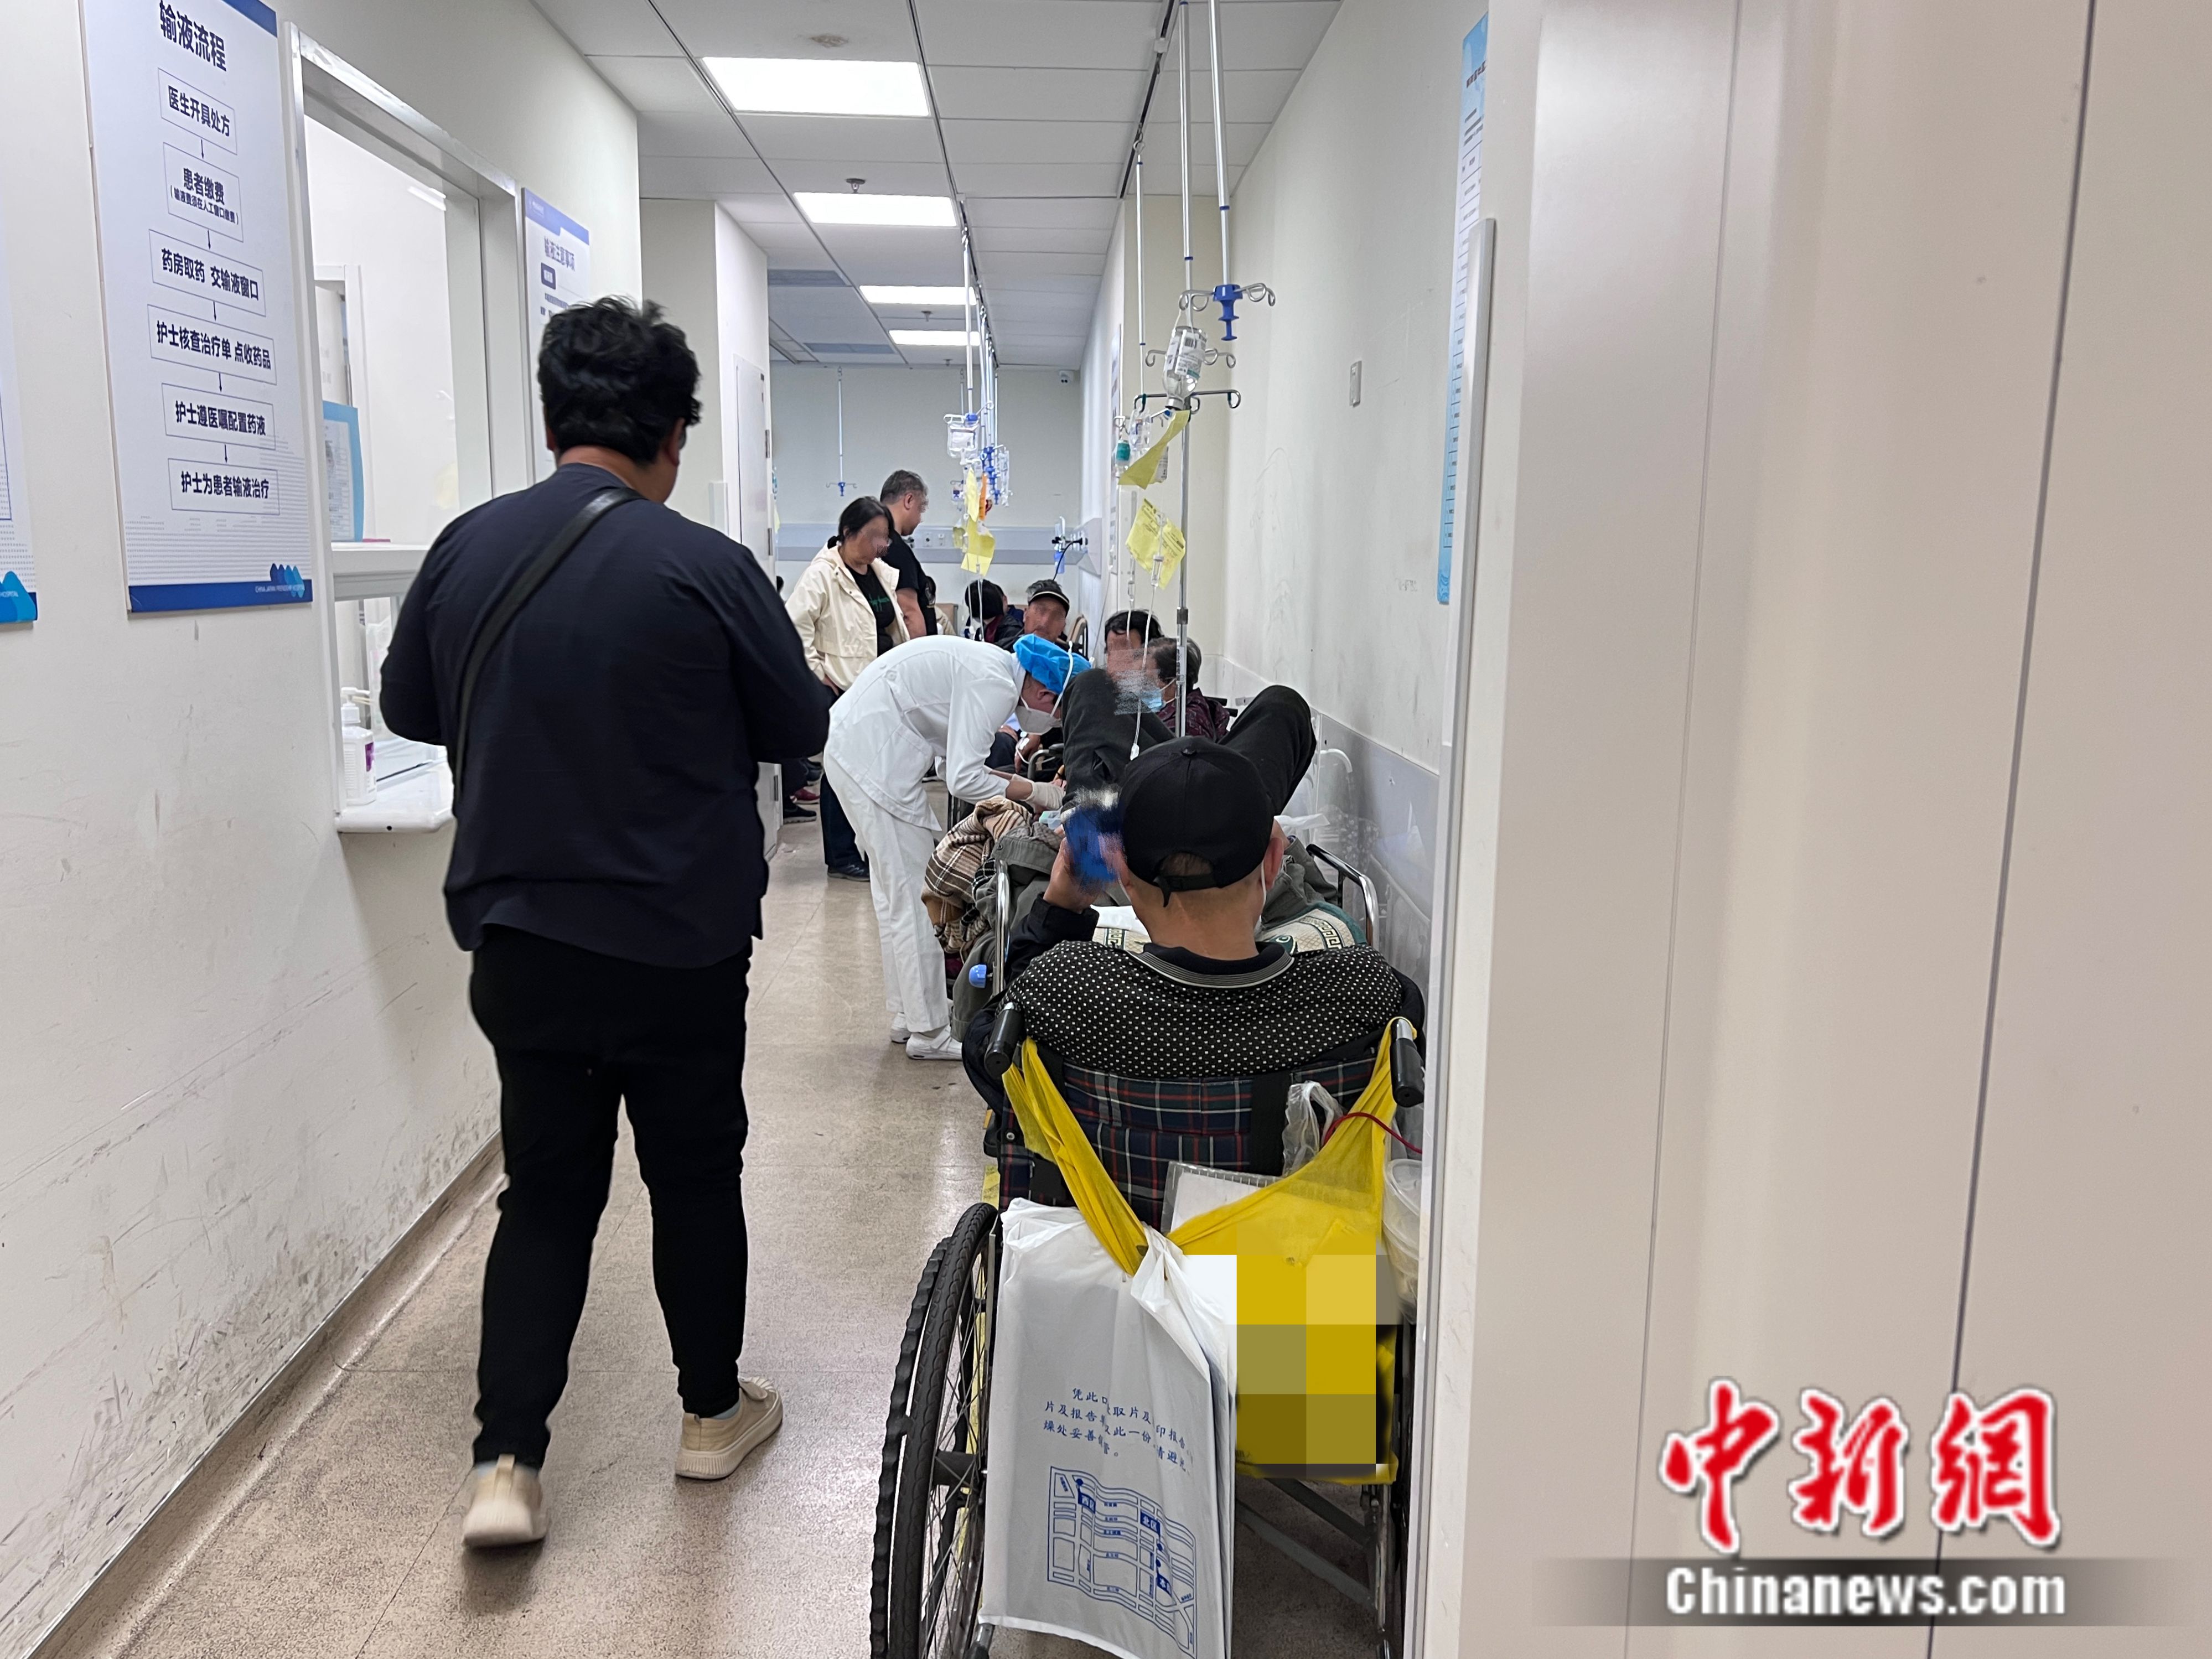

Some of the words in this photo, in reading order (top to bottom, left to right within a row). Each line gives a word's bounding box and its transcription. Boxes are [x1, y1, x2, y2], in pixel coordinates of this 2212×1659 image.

[159, 0, 226, 71] 输液流程
[168, 85, 230, 137] 医生开具处方
[183, 168, 224, 205] 患者缴费
[162, 248, 205, 283] 药房取药
[210, 266, 258, 300] 交输液窗口
[157, 320, 231, 360] 护士核查治疗单
[235, 341, 271, 370] 点收药品
[175, 400, 266, 436] 护士遵医嘱配置药液
[181, 471, 269, 499] 护士为患者输液治疗
